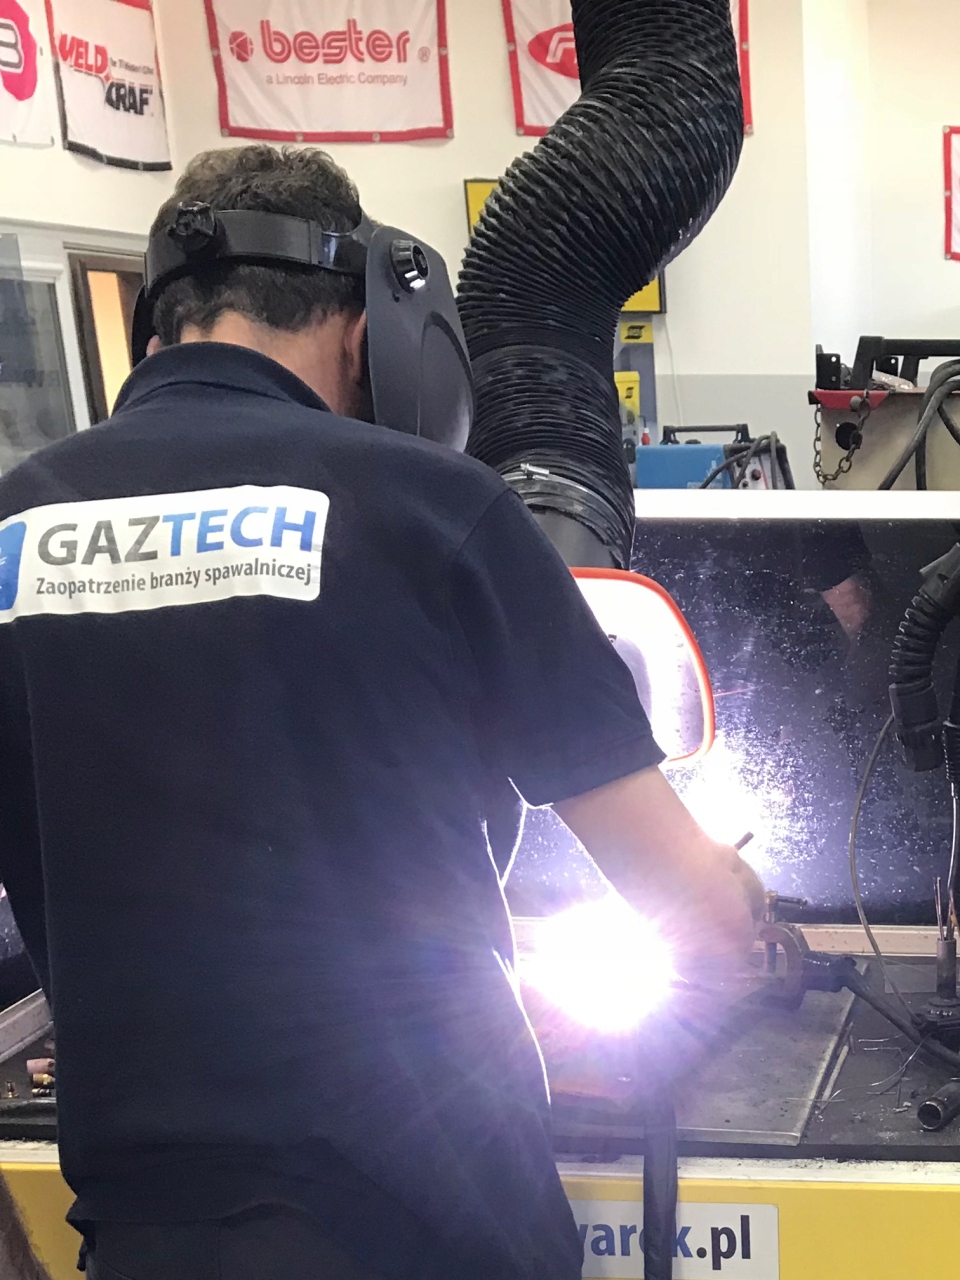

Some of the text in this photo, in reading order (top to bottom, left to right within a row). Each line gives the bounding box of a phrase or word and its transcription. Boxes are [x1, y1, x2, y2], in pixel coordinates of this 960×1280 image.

[260, 19, 410, 64] bester
[105, 81, 153, 115] KRAF
[266, 72, 408, 86] a Lincoln Electric Company
[38, 506, 316, 566] GAZTECH
[36, 558, 311, 598] Zaopatrzenie branży spawalniczej
[578, 1214, 751, 1271] ark.pl
